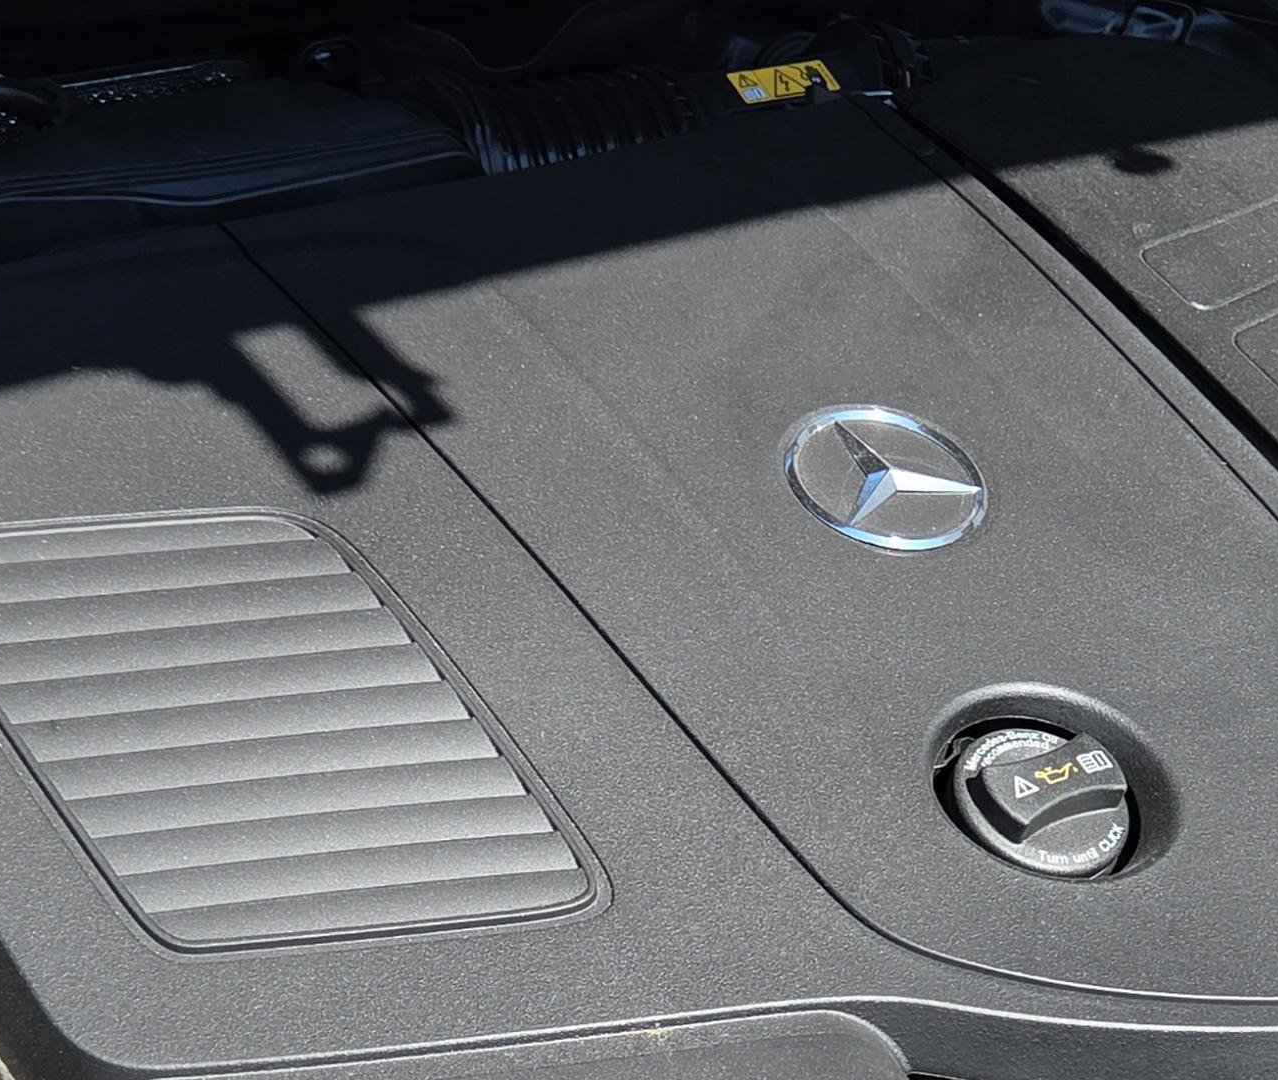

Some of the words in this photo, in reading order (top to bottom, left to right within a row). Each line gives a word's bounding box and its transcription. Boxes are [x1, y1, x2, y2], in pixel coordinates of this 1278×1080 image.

[963, 730, 1040, 771] Mercedes-Benz
[980, 739, 1050, 768] recommended
[1037, 849, 1069, 864] Turn
[1072, 847, 1100, 864] until
[1098, 822, 1125, 853] CLICK
